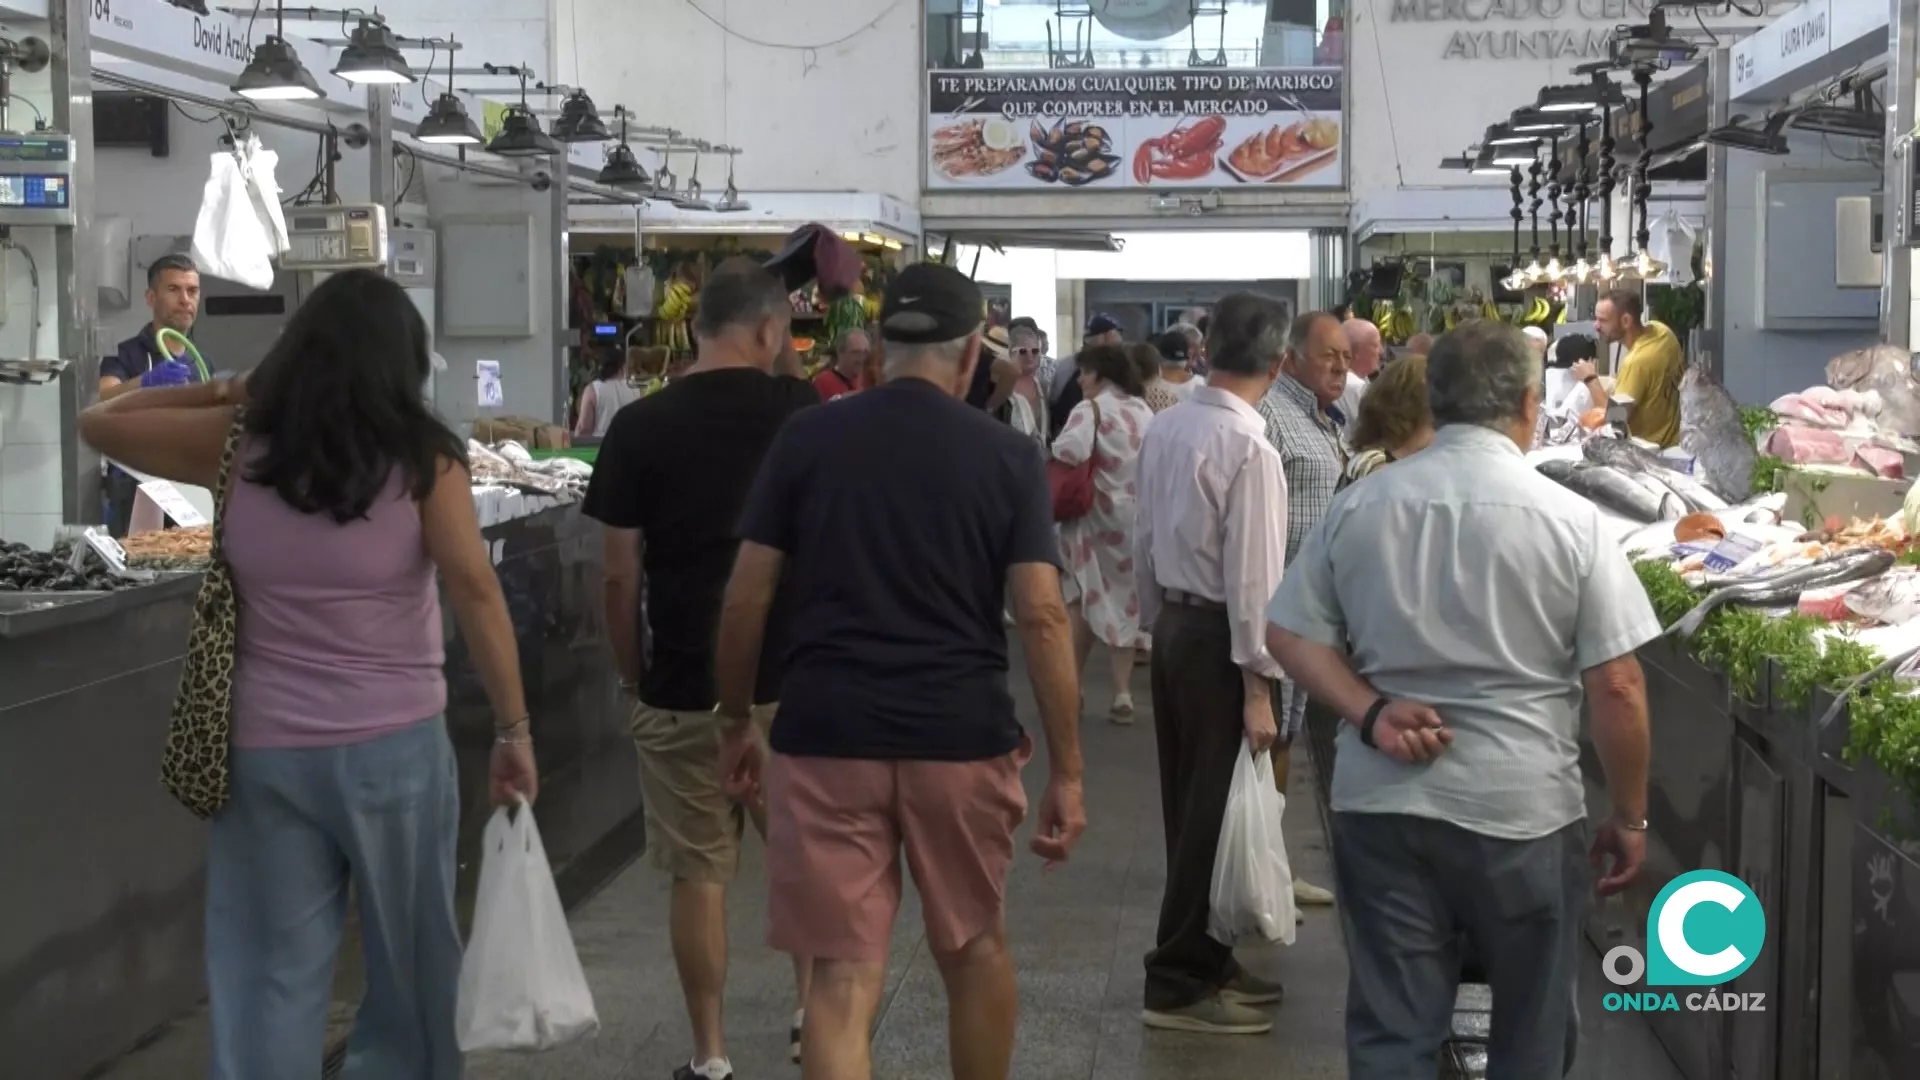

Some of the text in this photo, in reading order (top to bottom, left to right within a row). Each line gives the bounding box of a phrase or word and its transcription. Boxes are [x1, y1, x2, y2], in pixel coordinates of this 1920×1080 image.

[1391, 0, 1564, 21] MERCADO
[193, 15, 222, 55] David
[1806, 11, 1826, 47] DAVID
[938, 74, 1335, 96] TE PREPARAMOS CUALQUIER TIPO DE MARISCO
[1002, 99, 1269, 122] QUE COMPRES EN EL MERCADO
